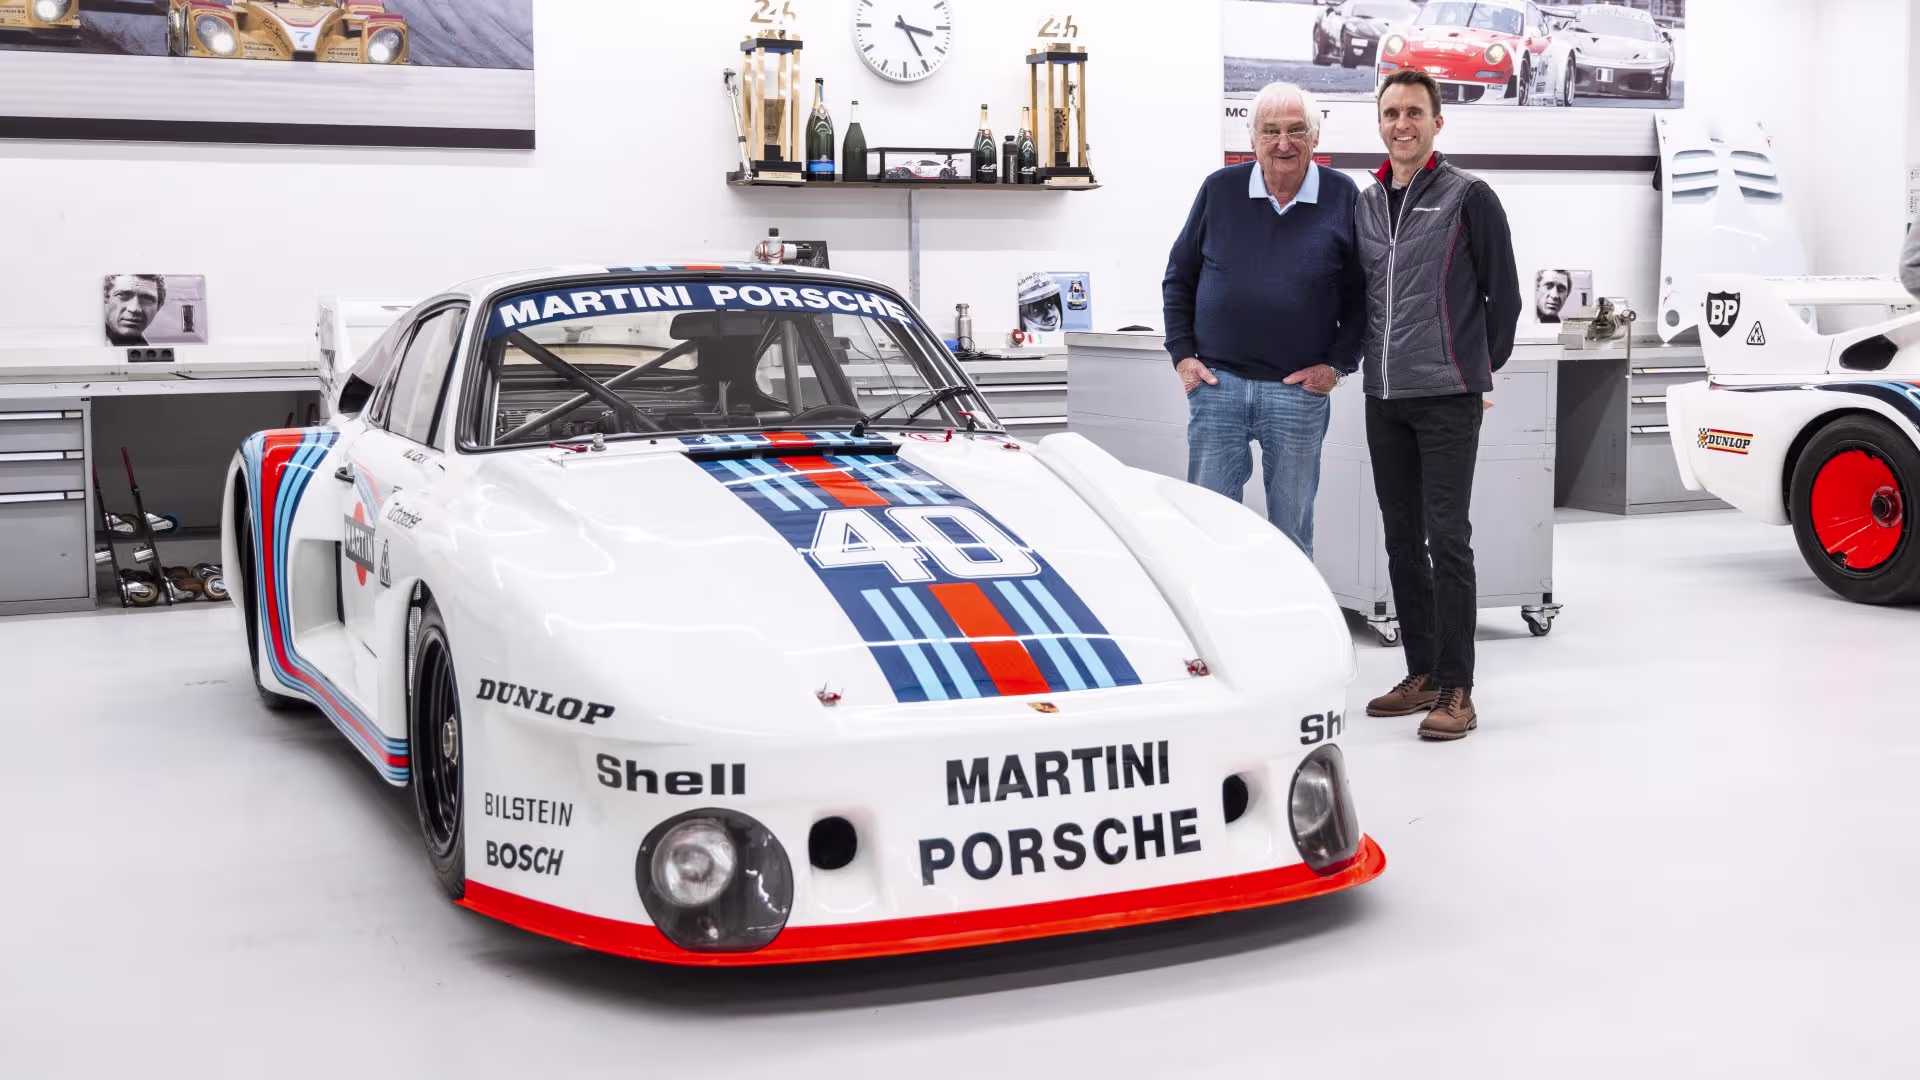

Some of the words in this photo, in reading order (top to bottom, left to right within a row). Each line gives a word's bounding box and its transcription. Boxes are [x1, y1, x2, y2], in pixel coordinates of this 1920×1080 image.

[295, 31, 311, 42] 7
[500, 286, 693, 328] MARTINI
[708, 285, 912, 325] PORSCHE
[1709, 299, 1738, 326] BP
[1708, 434, 1751, 449] DUNLOP
[809, 506, 1041, 583] 40
[476, 678, 615, 725] DUNLOP
[596, 753, 746, 796] Shell
[946, 740, 1170, 806] MARTINI
[485, 791, 573, 827] BILSTEIN
[486, 839, 564, 876] BOSCH
[919, 807, 1203, 886] PORSCHE
